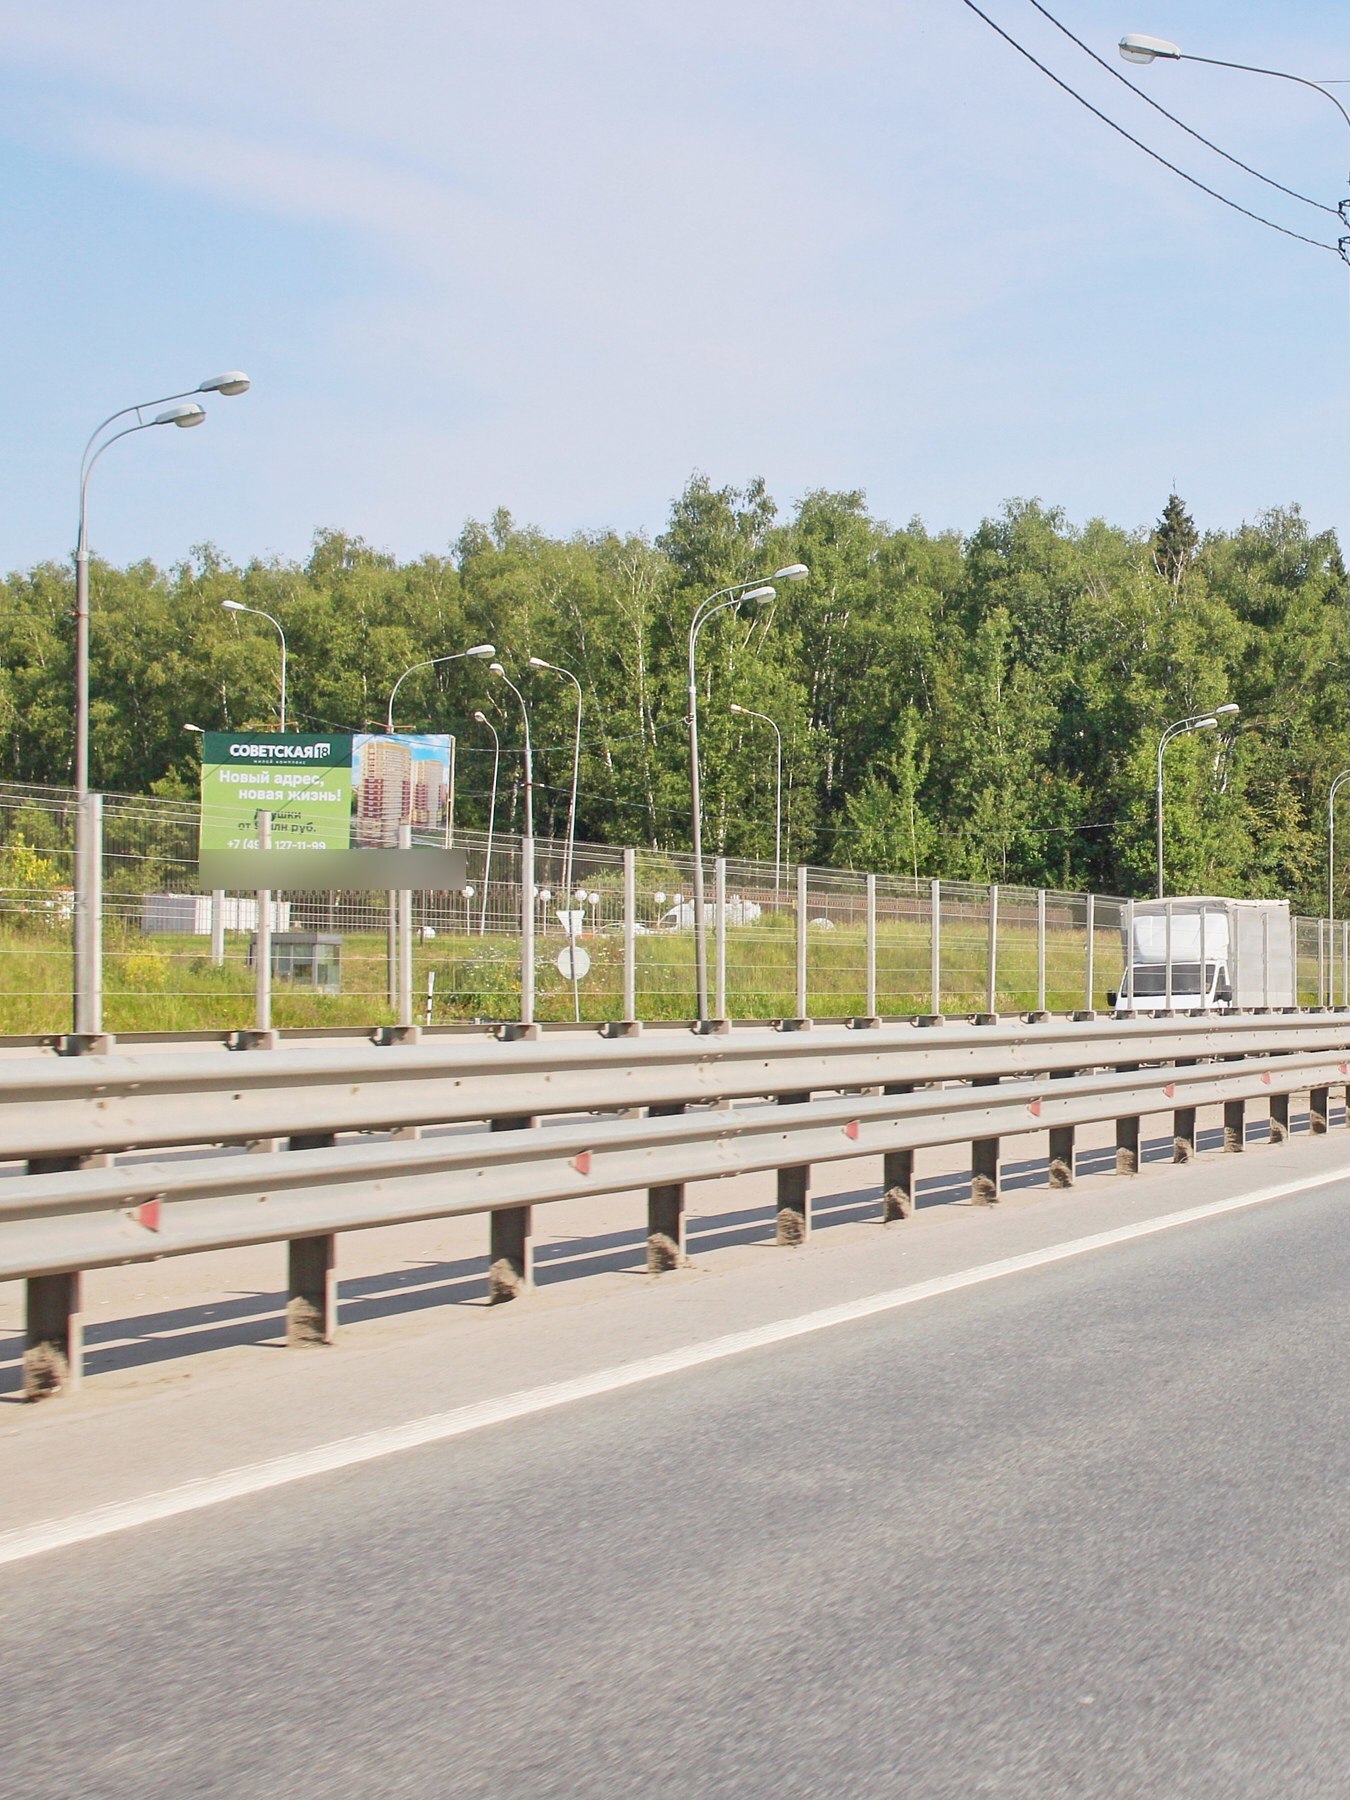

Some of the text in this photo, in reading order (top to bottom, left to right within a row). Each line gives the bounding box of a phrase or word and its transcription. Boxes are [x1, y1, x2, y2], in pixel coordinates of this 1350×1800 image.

[229, 744, 313, 758] СОВЕТСКАЯ
[219, 770, 325, 788] Новый адрес,
[239, 789, 342, 802] новая жизнь!
[291, 821, 316, 835] руб.
[226, 839, 240, 849] +7
[275, 840, 326, 850] 127-11-99
